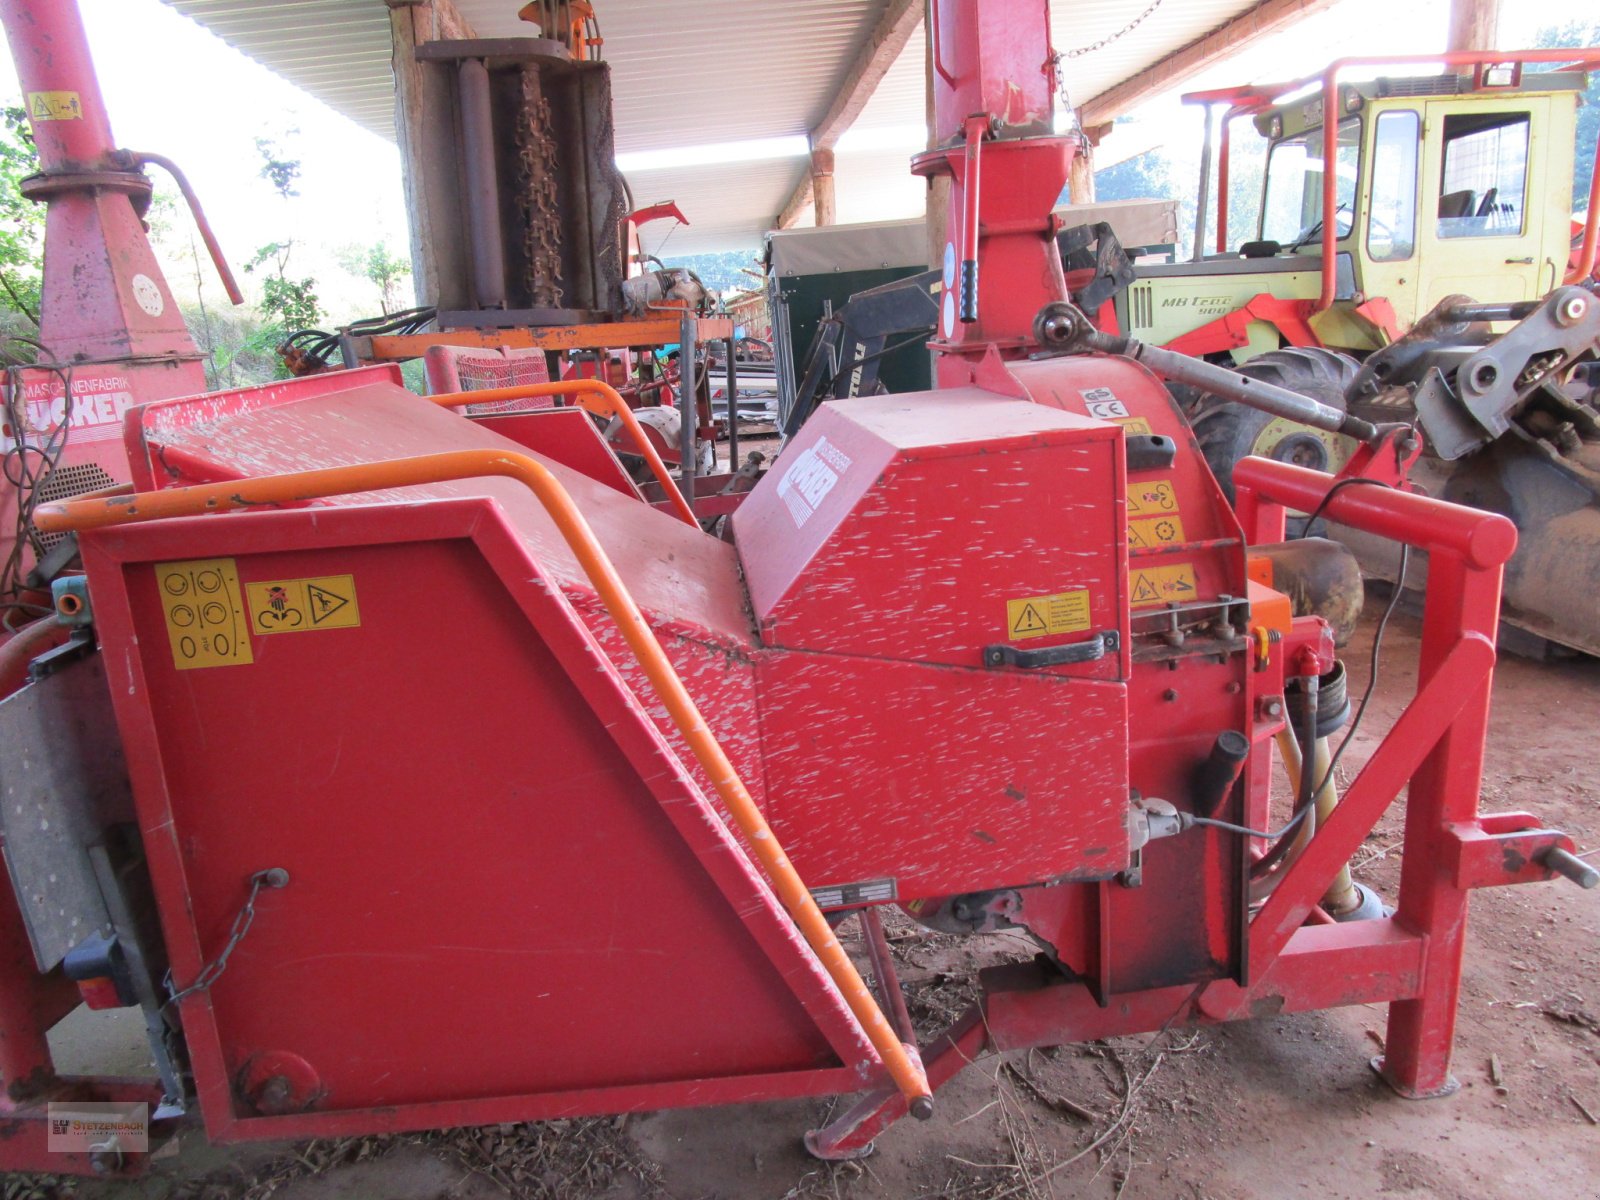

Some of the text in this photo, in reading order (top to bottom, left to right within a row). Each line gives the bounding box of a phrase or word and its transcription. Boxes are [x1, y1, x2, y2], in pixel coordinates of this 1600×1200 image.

[1161, 297, 1188, 308] MB
[25, 377, 131, 399] MASCHNENFABRIK
[1084, 389, 1110, 400] GS
[1093, 402, 1123, 417] CE
